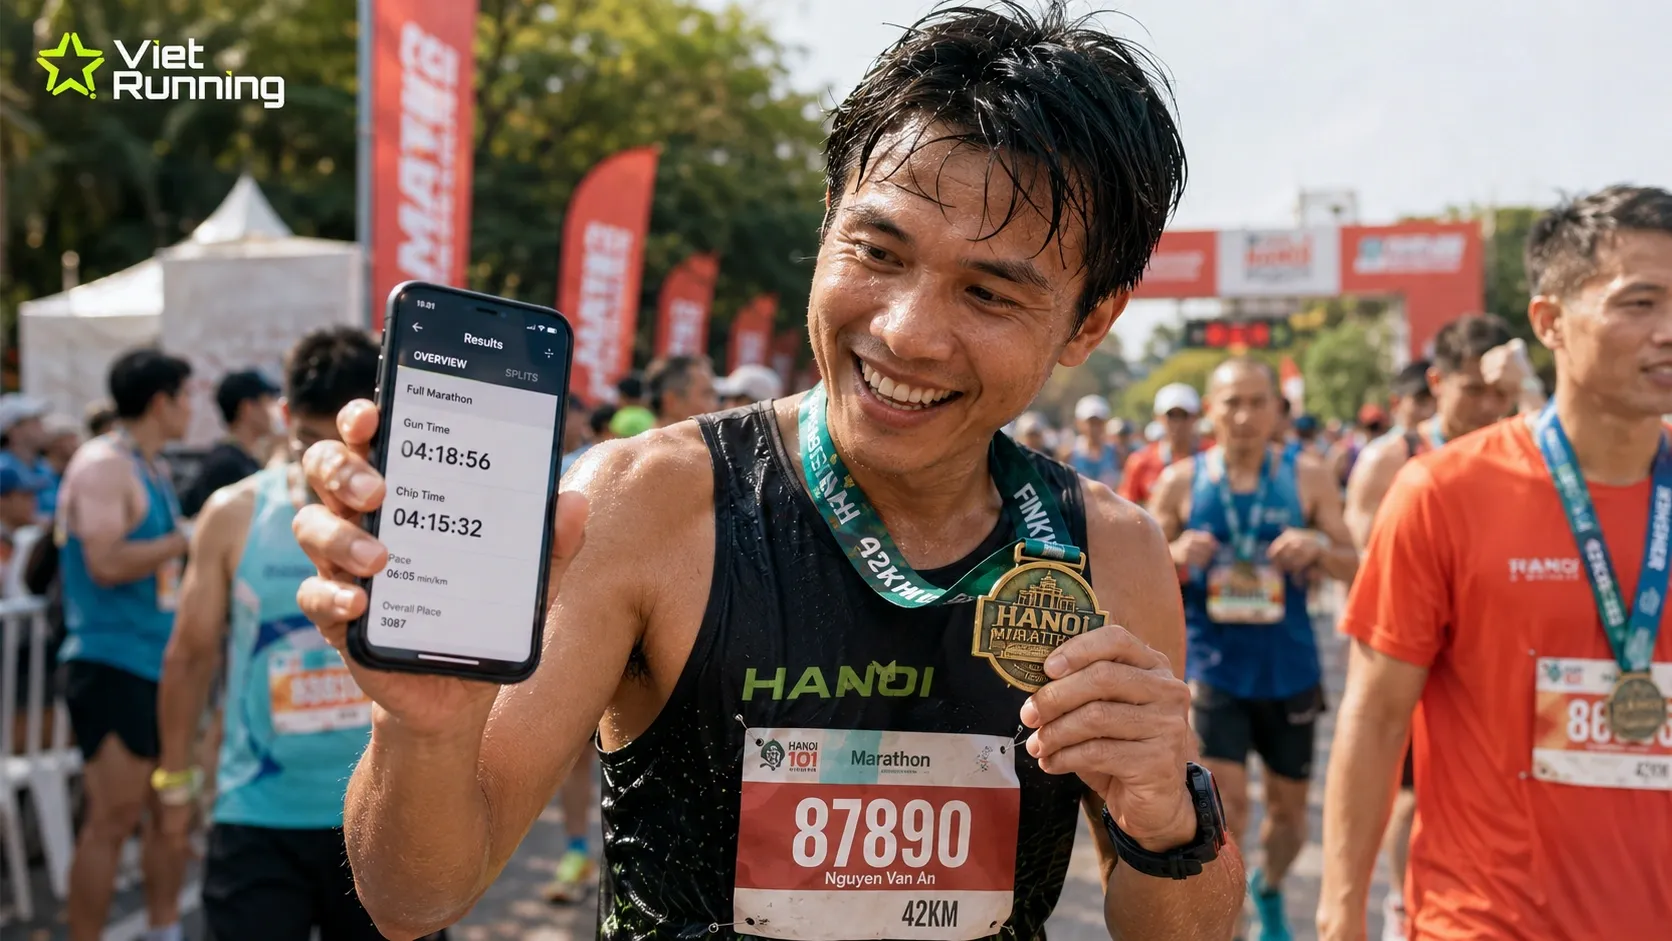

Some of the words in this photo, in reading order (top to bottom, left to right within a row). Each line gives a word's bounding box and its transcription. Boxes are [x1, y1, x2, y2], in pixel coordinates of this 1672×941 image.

[464, 333, 504, 350] Results
[413, 351, 468, 369] OVERVIEW
[505, 368, 539, 382] SPLITS
[407, 385, 425, 395] Full
[427, 388, 473, 405] Marathon
[403, 418, 424, 430] Gun
[427, 422, 451, 435] Time
[401, 440, 491, 470] 04:18:56
[396, 486, 419, 499] Chip
[422, 490, 446, 503] Time
[393, 508, 483, 538] 04:15:32
[388, 553, 412, 566] Pace
[386, 569, 415, 582] 06:05
[417, 574, 448, 586] min/km
[382, 601, 415, 614] Overall
[417, 605, 442, 617] Place
[380, 617, 406, 629] 3087
[996, 604, 1091, 636] HANOI
[742, 665, 934, 701] HANOI
[788, 741, 818, 751] HANOI
[788, 751, 818, 768] 101
[851, 750, 930, 768] Marathon
[792, 797, 972, 868] 87890
[825, 871, 882, 888] Nguyen
[886, 871, 914, 886] Van
[916, 871, 936, 885] An
[901, 899, 958, 928] 42KM
